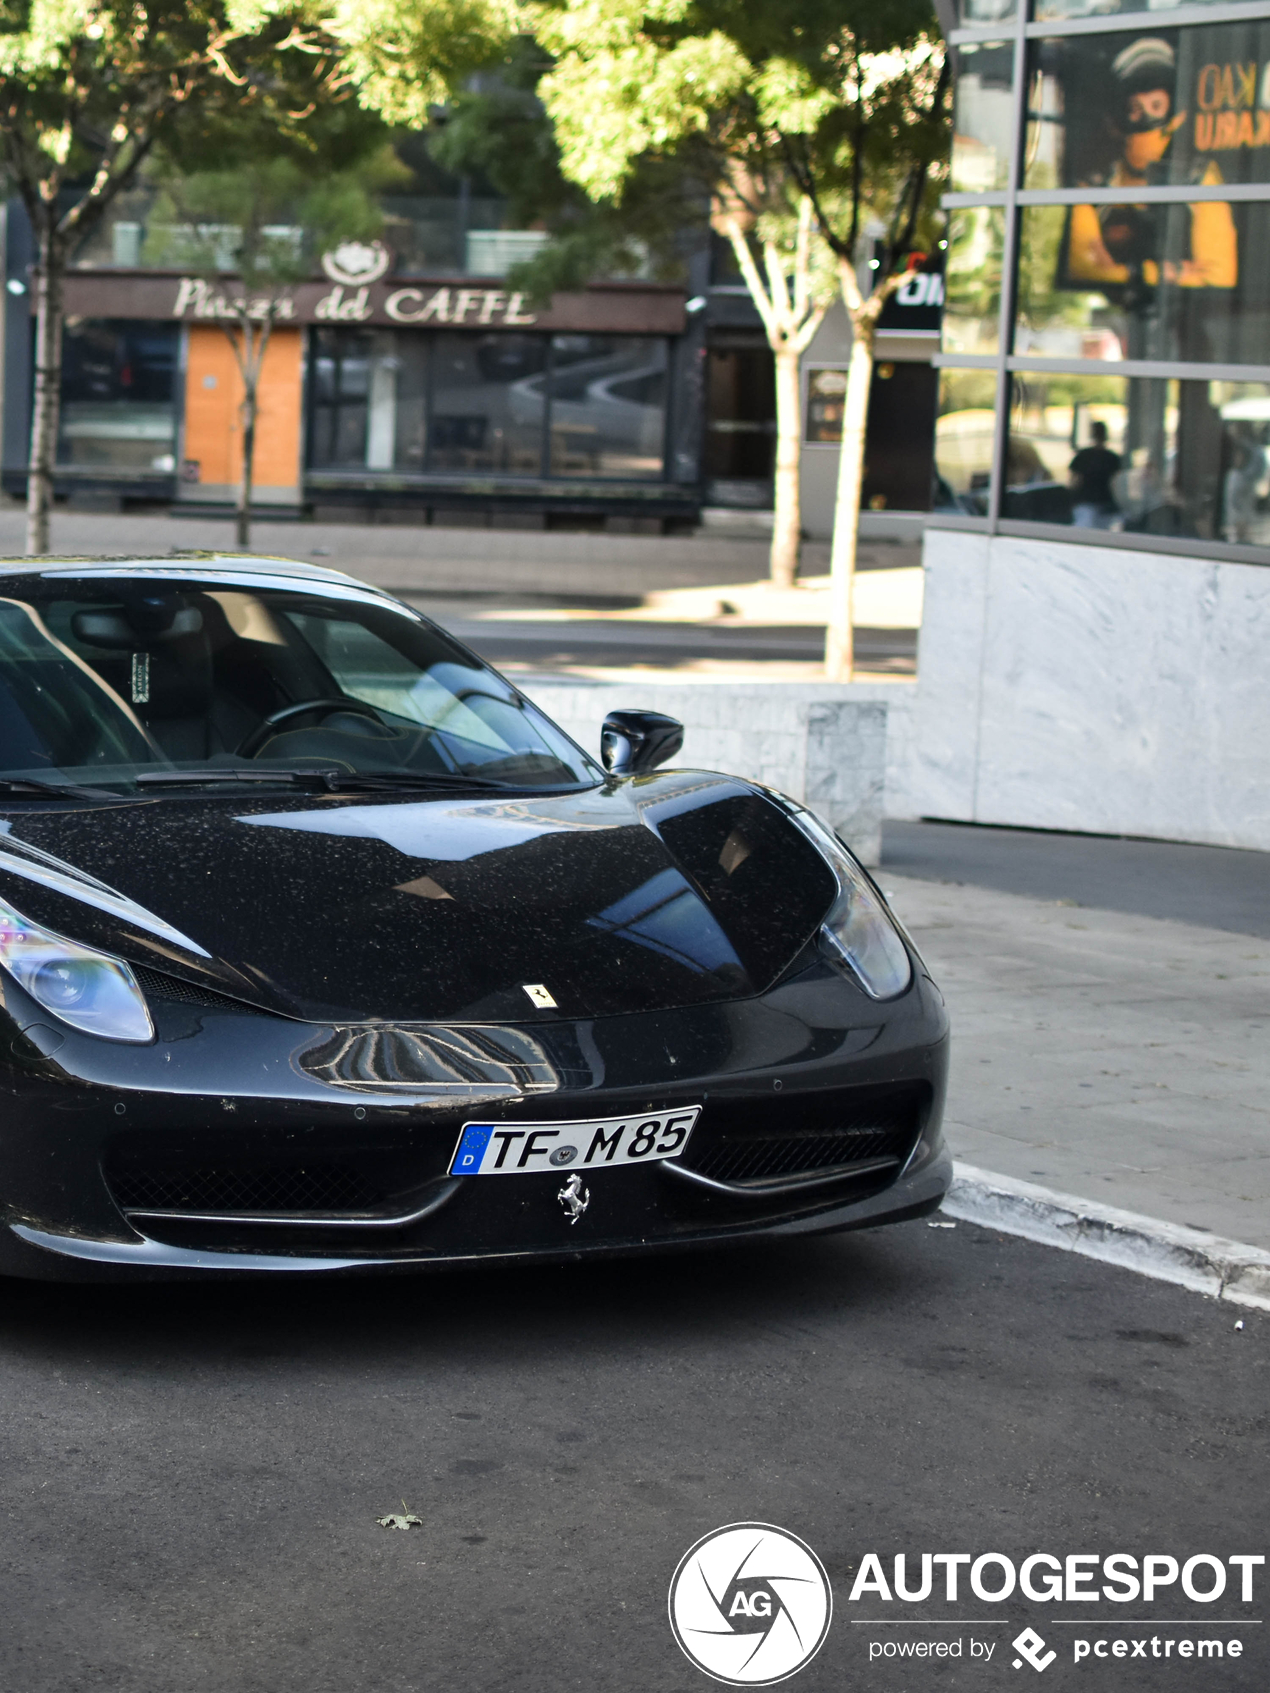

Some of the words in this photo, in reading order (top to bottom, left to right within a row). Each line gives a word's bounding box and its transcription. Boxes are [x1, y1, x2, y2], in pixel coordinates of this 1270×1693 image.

[315, 285, 373, 321] del
[385, 288, 538, 325] CAFFE
[462, 1154, 474, 1167] D
[493, 1130, 560, 1169] TF
